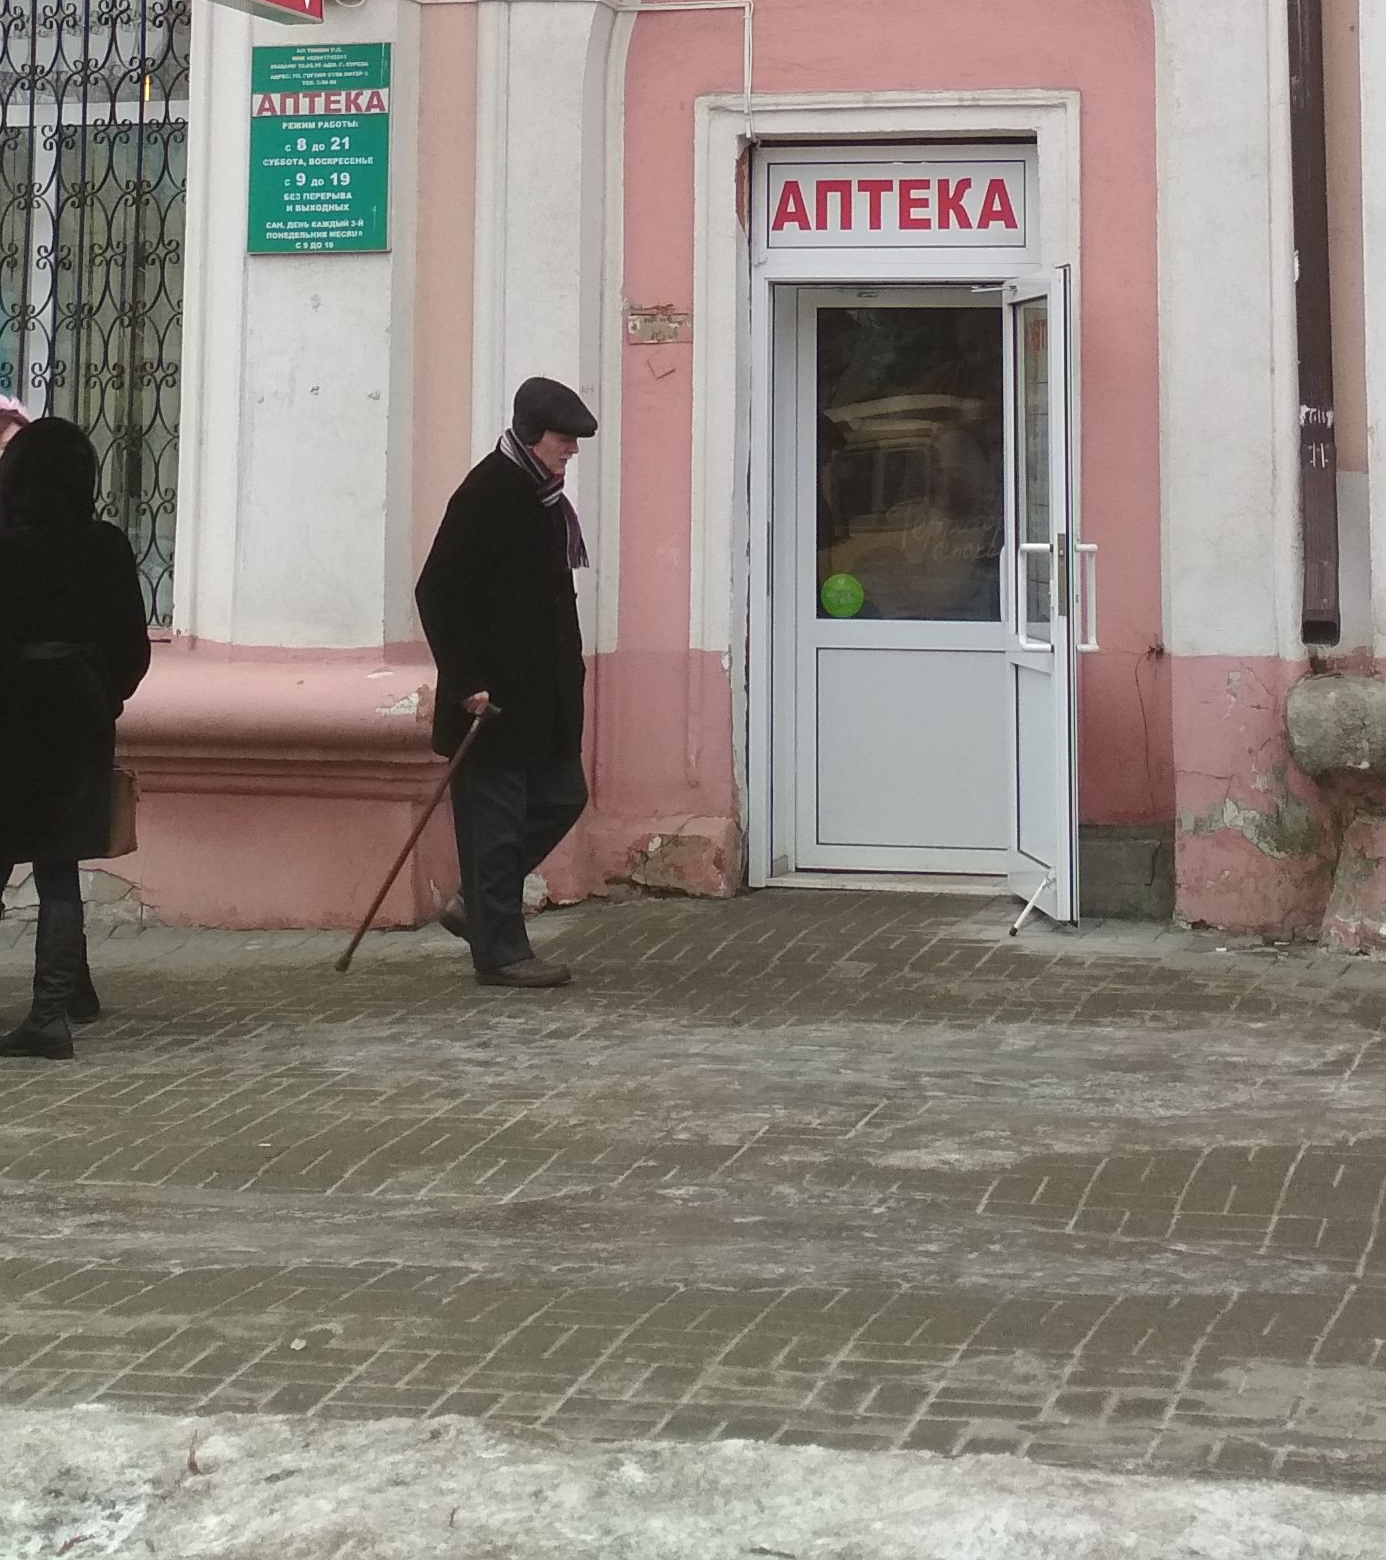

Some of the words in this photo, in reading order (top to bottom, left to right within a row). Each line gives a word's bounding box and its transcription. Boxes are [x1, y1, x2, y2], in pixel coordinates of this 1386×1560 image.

[256, 91, 386, 115] АПТЕКА
[282, 121, 315, 129] РЕЖИМ
[318, 120, 359, 128] РАБОТЫ:
[296, 137, 307, 151] 8
[330, 136, 350, 151] 21
[262, 158, 307, 166] СУББОТА,
[308, 156, 373, 165] ВОСКРЕСЕНЬЕ
[295, 172, 306, 186] 9
[329, 172, 350, 185] 19
[283, 193, 300, 201] БЕЗ
[302, 192, 352, 200] ПЕРЕРЫВА
[286, 204, 293, 212] И
[295, 203, 349, 213] ВЫХОДНЫХ
[771, 177, 1018, 231] АПТЕКА
[266, 221, 285, 229] САН.
[286, 221, 309, 229] ДЕНЬ
[311, 219, 349, 229] КАЖДЫЙ
[266, 231, 327, 240] ПОНЕДЕЛЬНИК
